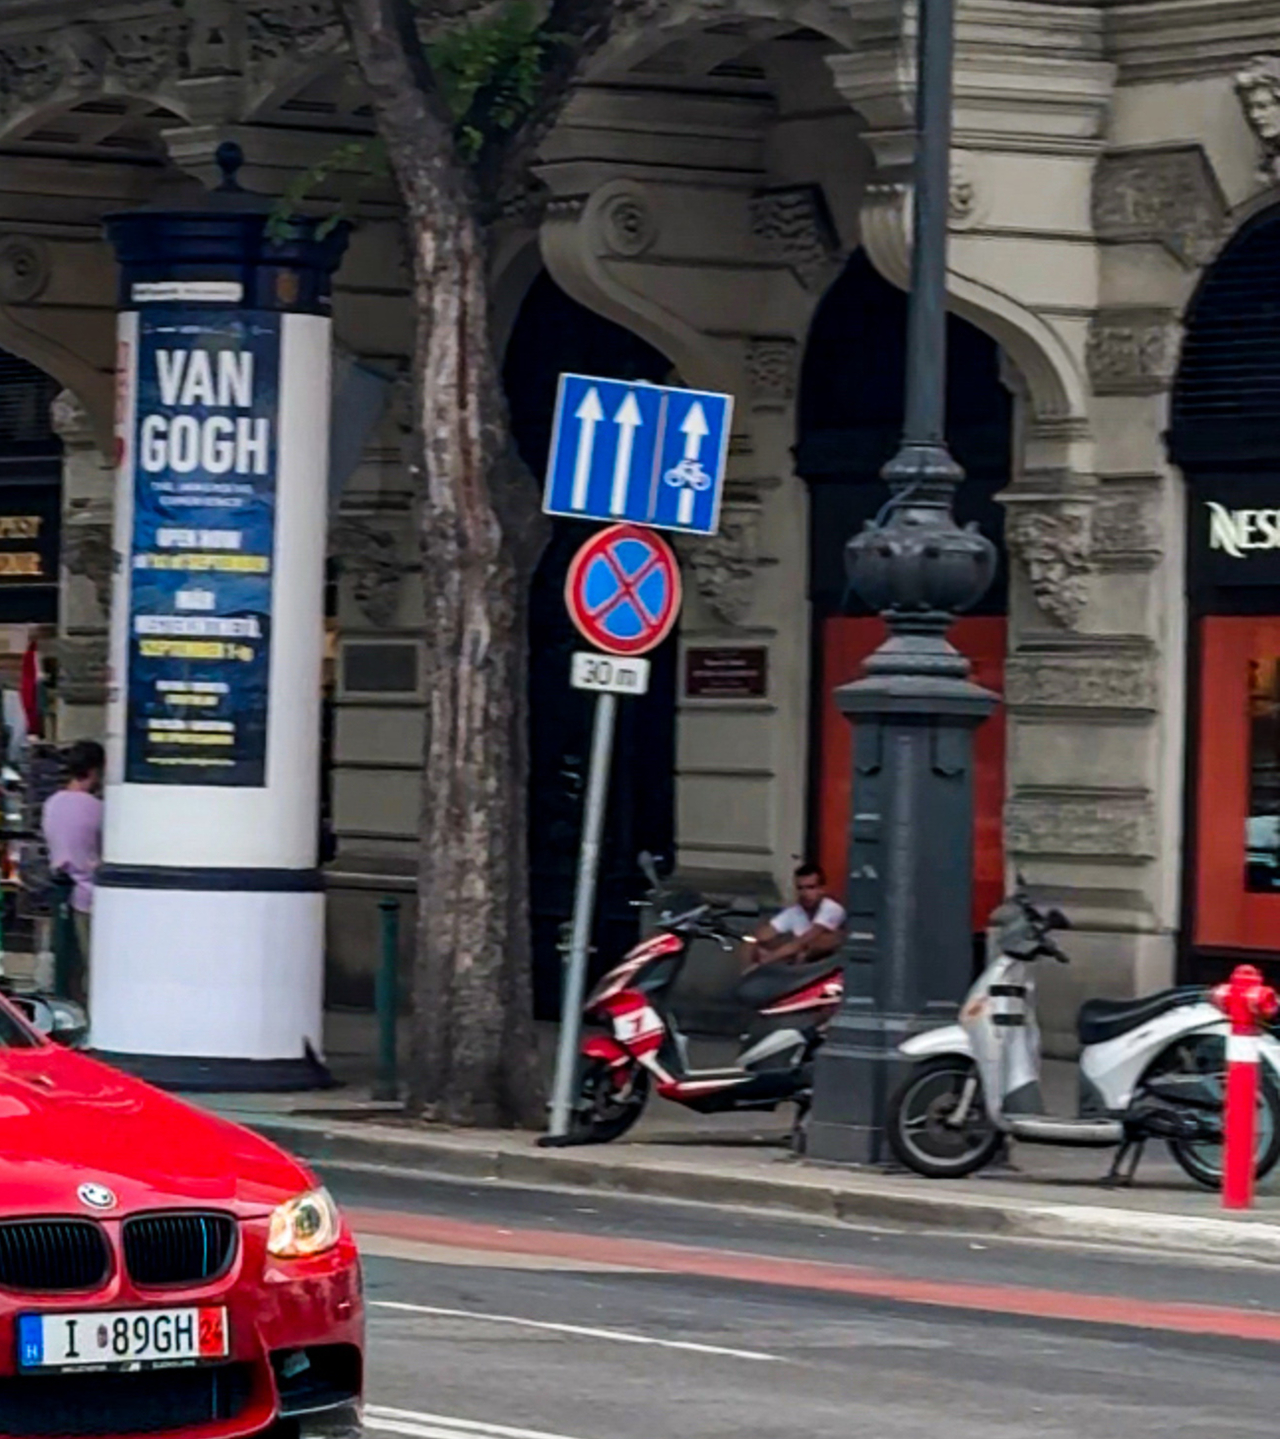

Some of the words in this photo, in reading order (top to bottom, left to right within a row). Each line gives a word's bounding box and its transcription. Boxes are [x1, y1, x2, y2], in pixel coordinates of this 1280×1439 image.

[155, 349, 253, 407] VAN
[140, 414, 269, 475] GOGH
[583, 659, 612, 686] 30
[616, 668, 637, 687] m
[26, 1345, 38, 1359] H
[65, 1320, 80, 1358] I
[111, 1314, 194, 1356] 89GH
